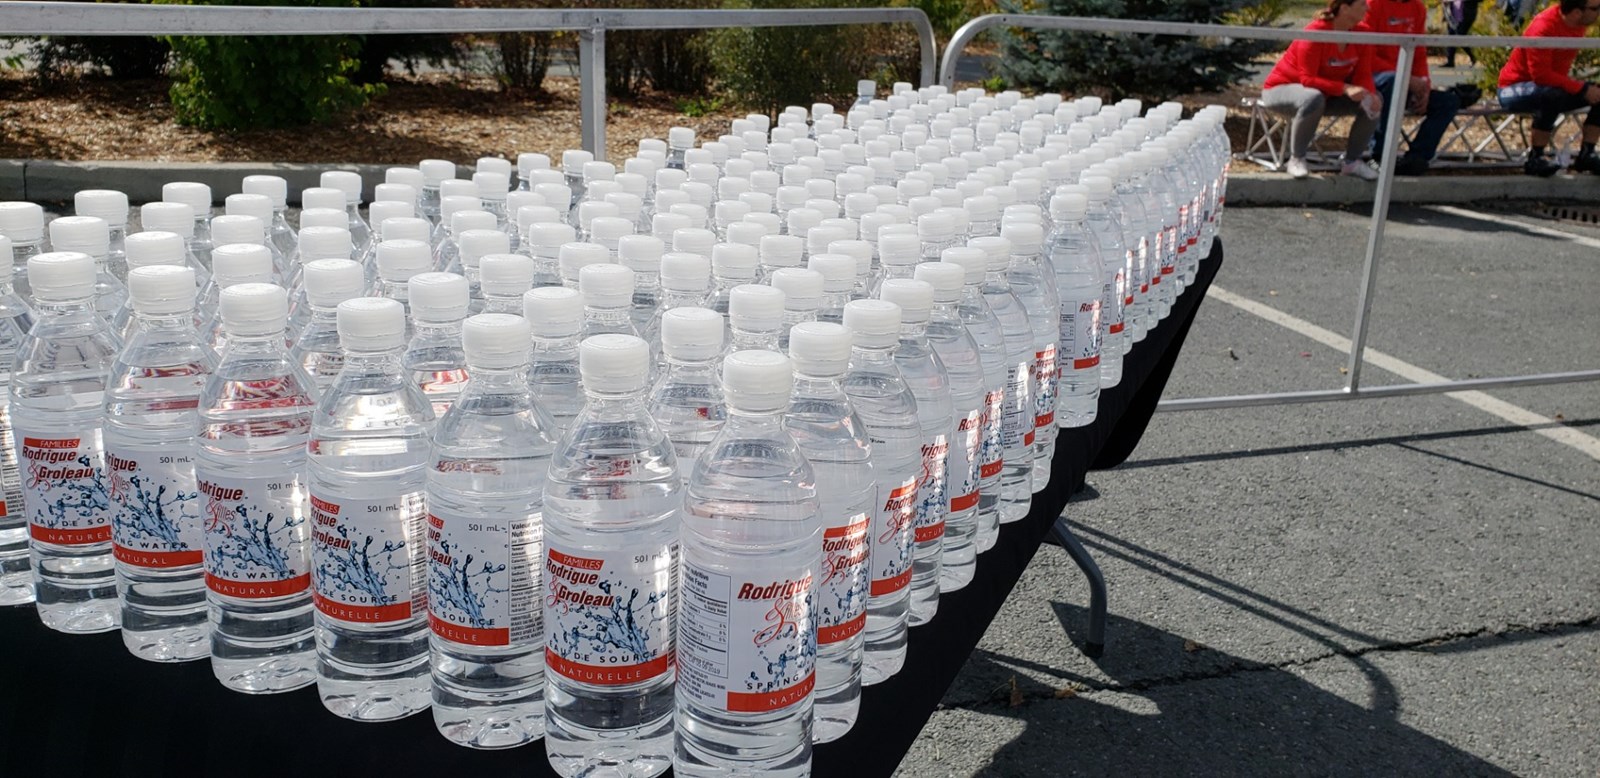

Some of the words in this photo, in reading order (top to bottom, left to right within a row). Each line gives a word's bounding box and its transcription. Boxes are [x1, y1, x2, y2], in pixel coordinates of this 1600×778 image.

[40, 440, 78, 448] FAMILLES
[22, 446, 77, 464] Rodrigue
[106, 451, 137, 472] rigue
[159, 456, 174, 464] 501
[38, 466, 95, 480] Groleau
[198, 480, 243, 501] odrigue
[312, 507, 337, 527] rigue
[49, 531, 112, 541] NATUREL
[915, 527, 944, 540] NATUR
[140, 541, 189, 549] WATER
[427, 546, 452, 566] leau
[563, 555, 601, 570] FAMILLES
[634, 555, 649, 563] 501
[246, 569, 296, 579] WATER
[546, 558, 598, 585] Rodrigue
[215, 583, 276, 595] NATURAL
[559, 585, 614, 606] Groleau
[738, 576, 812, 600] Rodrigue
[341, 594, 398, 604] SOURCE
[443, 610, 495, 626] SOURCE
[430, 621, 477, 642] TURELLE
[549, 640, 567, 656] EAU
[574, 652, 590, 661] DE
[600, 649, 658, 663] SOURCE
[560, 664, 641, 680] NATURELLE
[747, 674, 799, 690] SPRING
